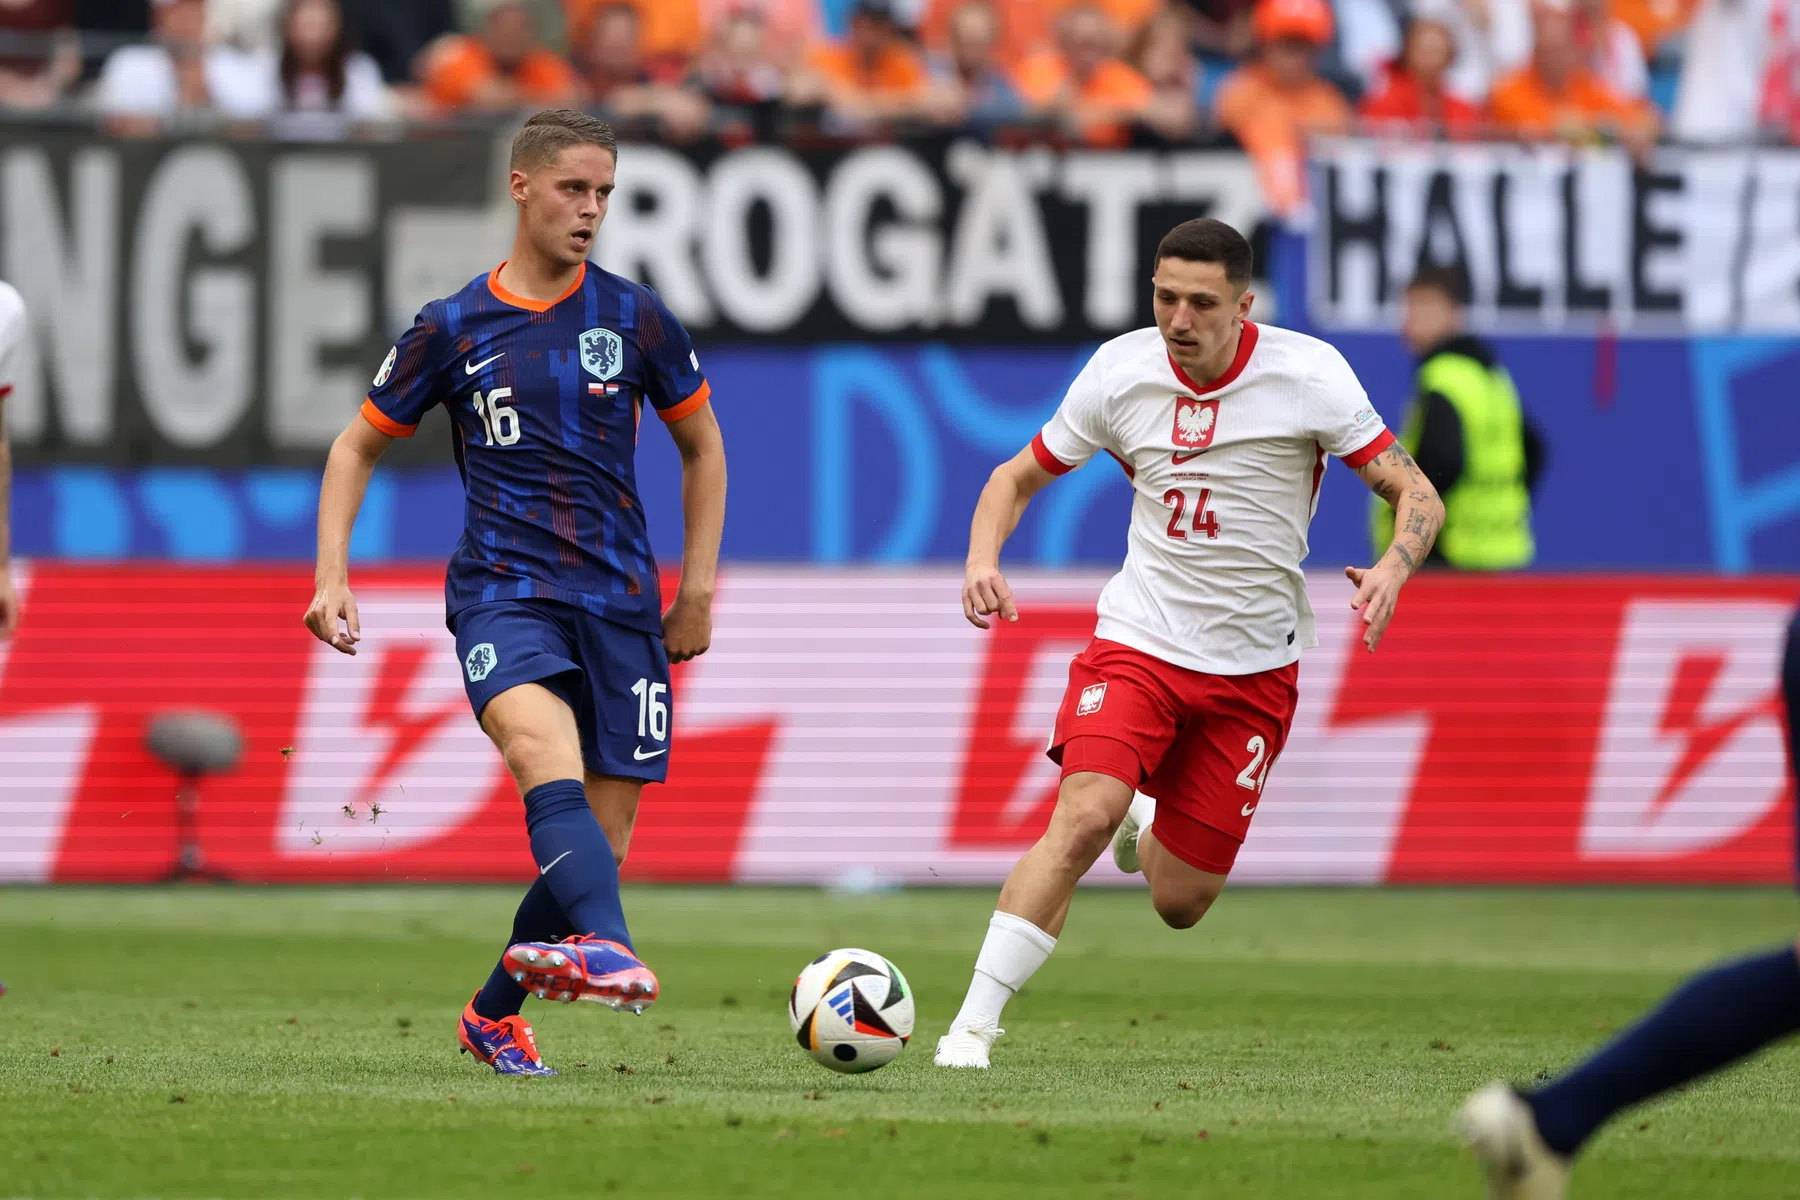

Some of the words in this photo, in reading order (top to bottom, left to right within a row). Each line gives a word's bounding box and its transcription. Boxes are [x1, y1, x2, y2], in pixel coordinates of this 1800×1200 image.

[472, 387, 521, 446] 16
[1163, 488, 1220, 540] 24
[631, 678, 668, 741] 16
